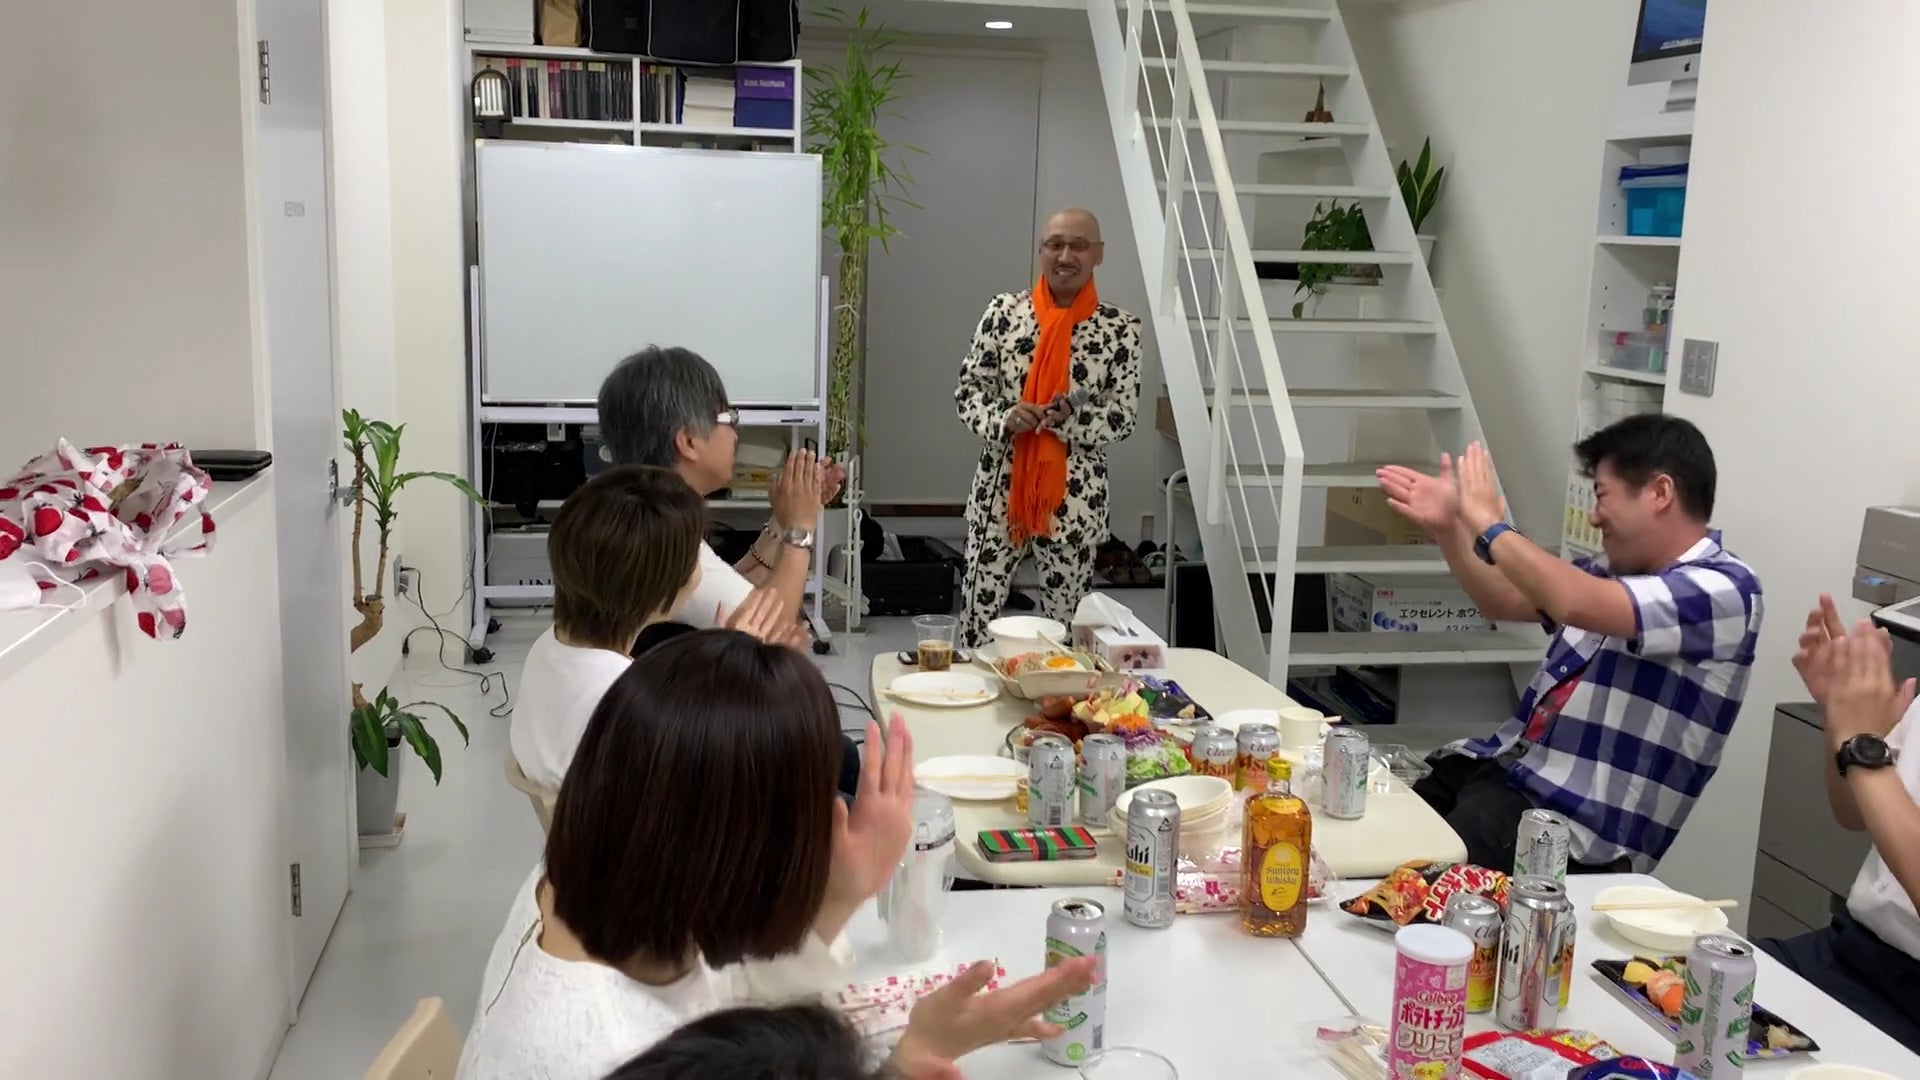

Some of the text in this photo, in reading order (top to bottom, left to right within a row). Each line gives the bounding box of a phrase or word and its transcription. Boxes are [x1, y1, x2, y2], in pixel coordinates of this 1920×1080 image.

[1399, 608, 1454, 619] エクセレント
[1418, 991, 1458, 1004] Calbee
